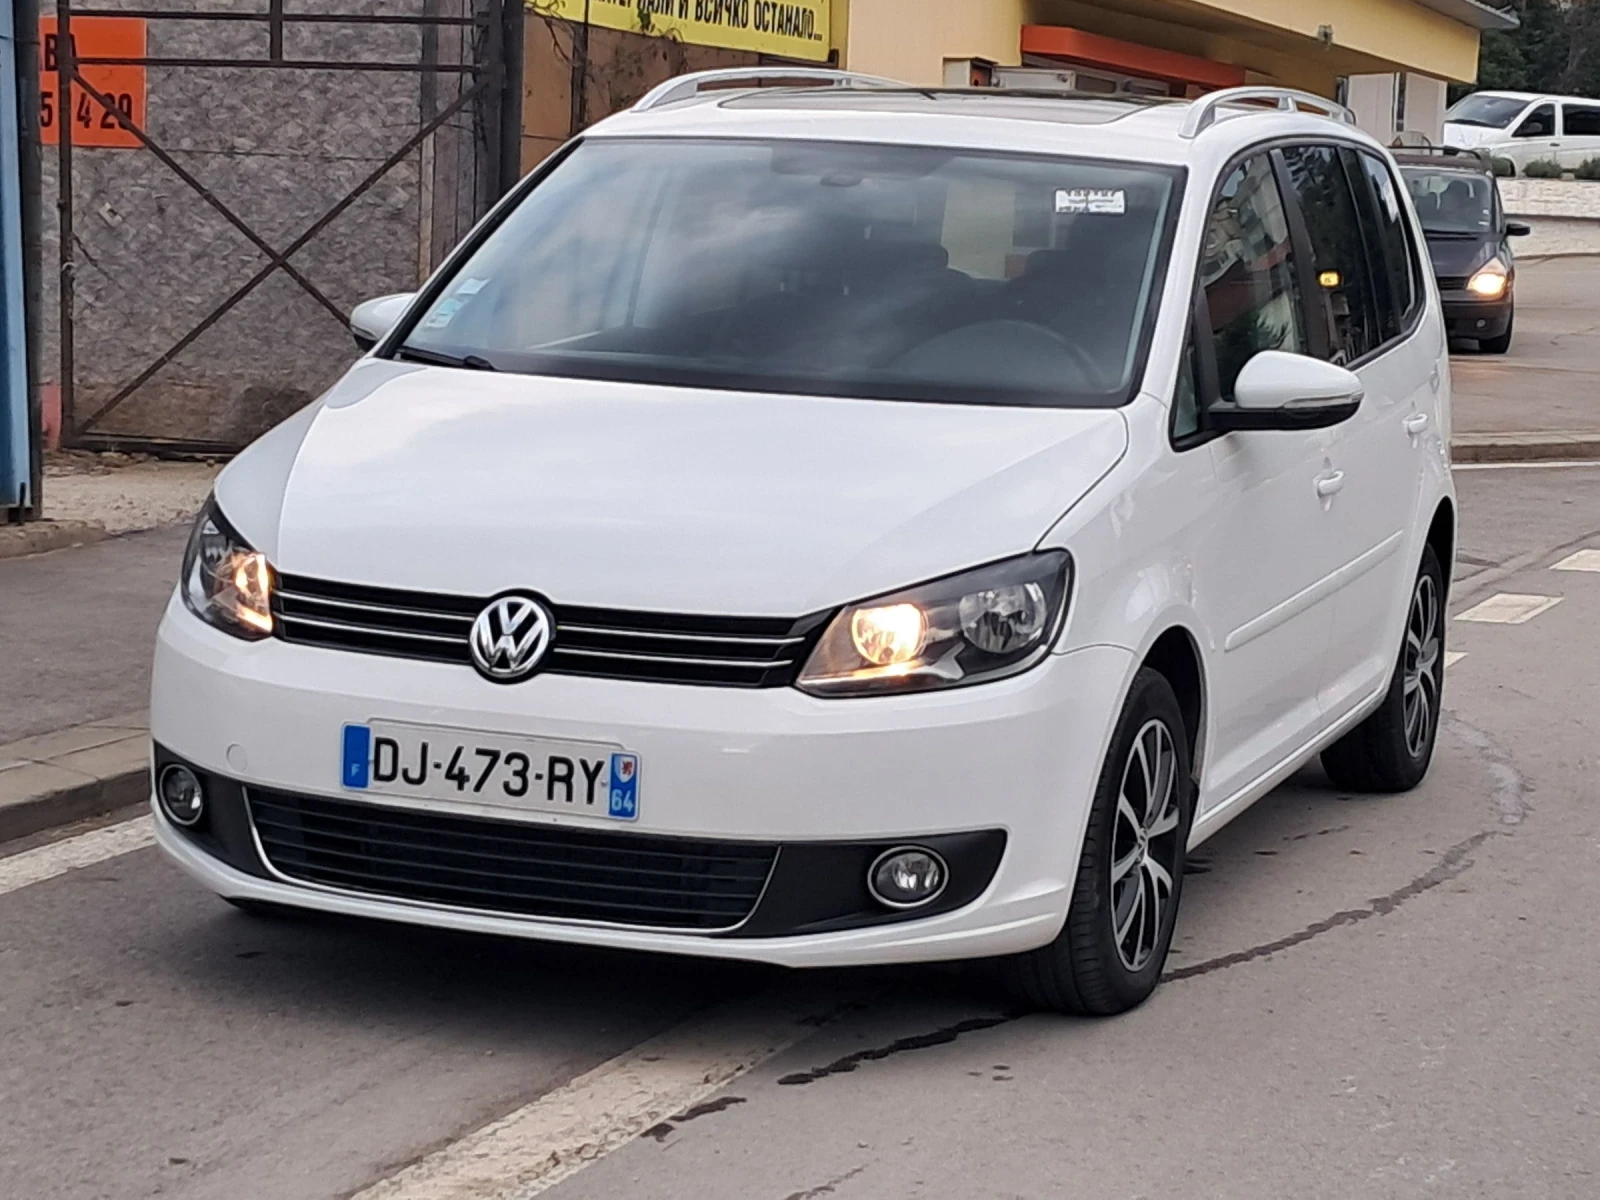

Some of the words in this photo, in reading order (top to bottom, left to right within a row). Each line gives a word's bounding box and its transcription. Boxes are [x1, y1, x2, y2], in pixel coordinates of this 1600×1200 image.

[694, 0, 749, 29] ВСИЧКО
[350, 763, 361, 777] F
[373, 737, 605, 805] DJ-473-RY
[611, 788, 634, 812] 64
